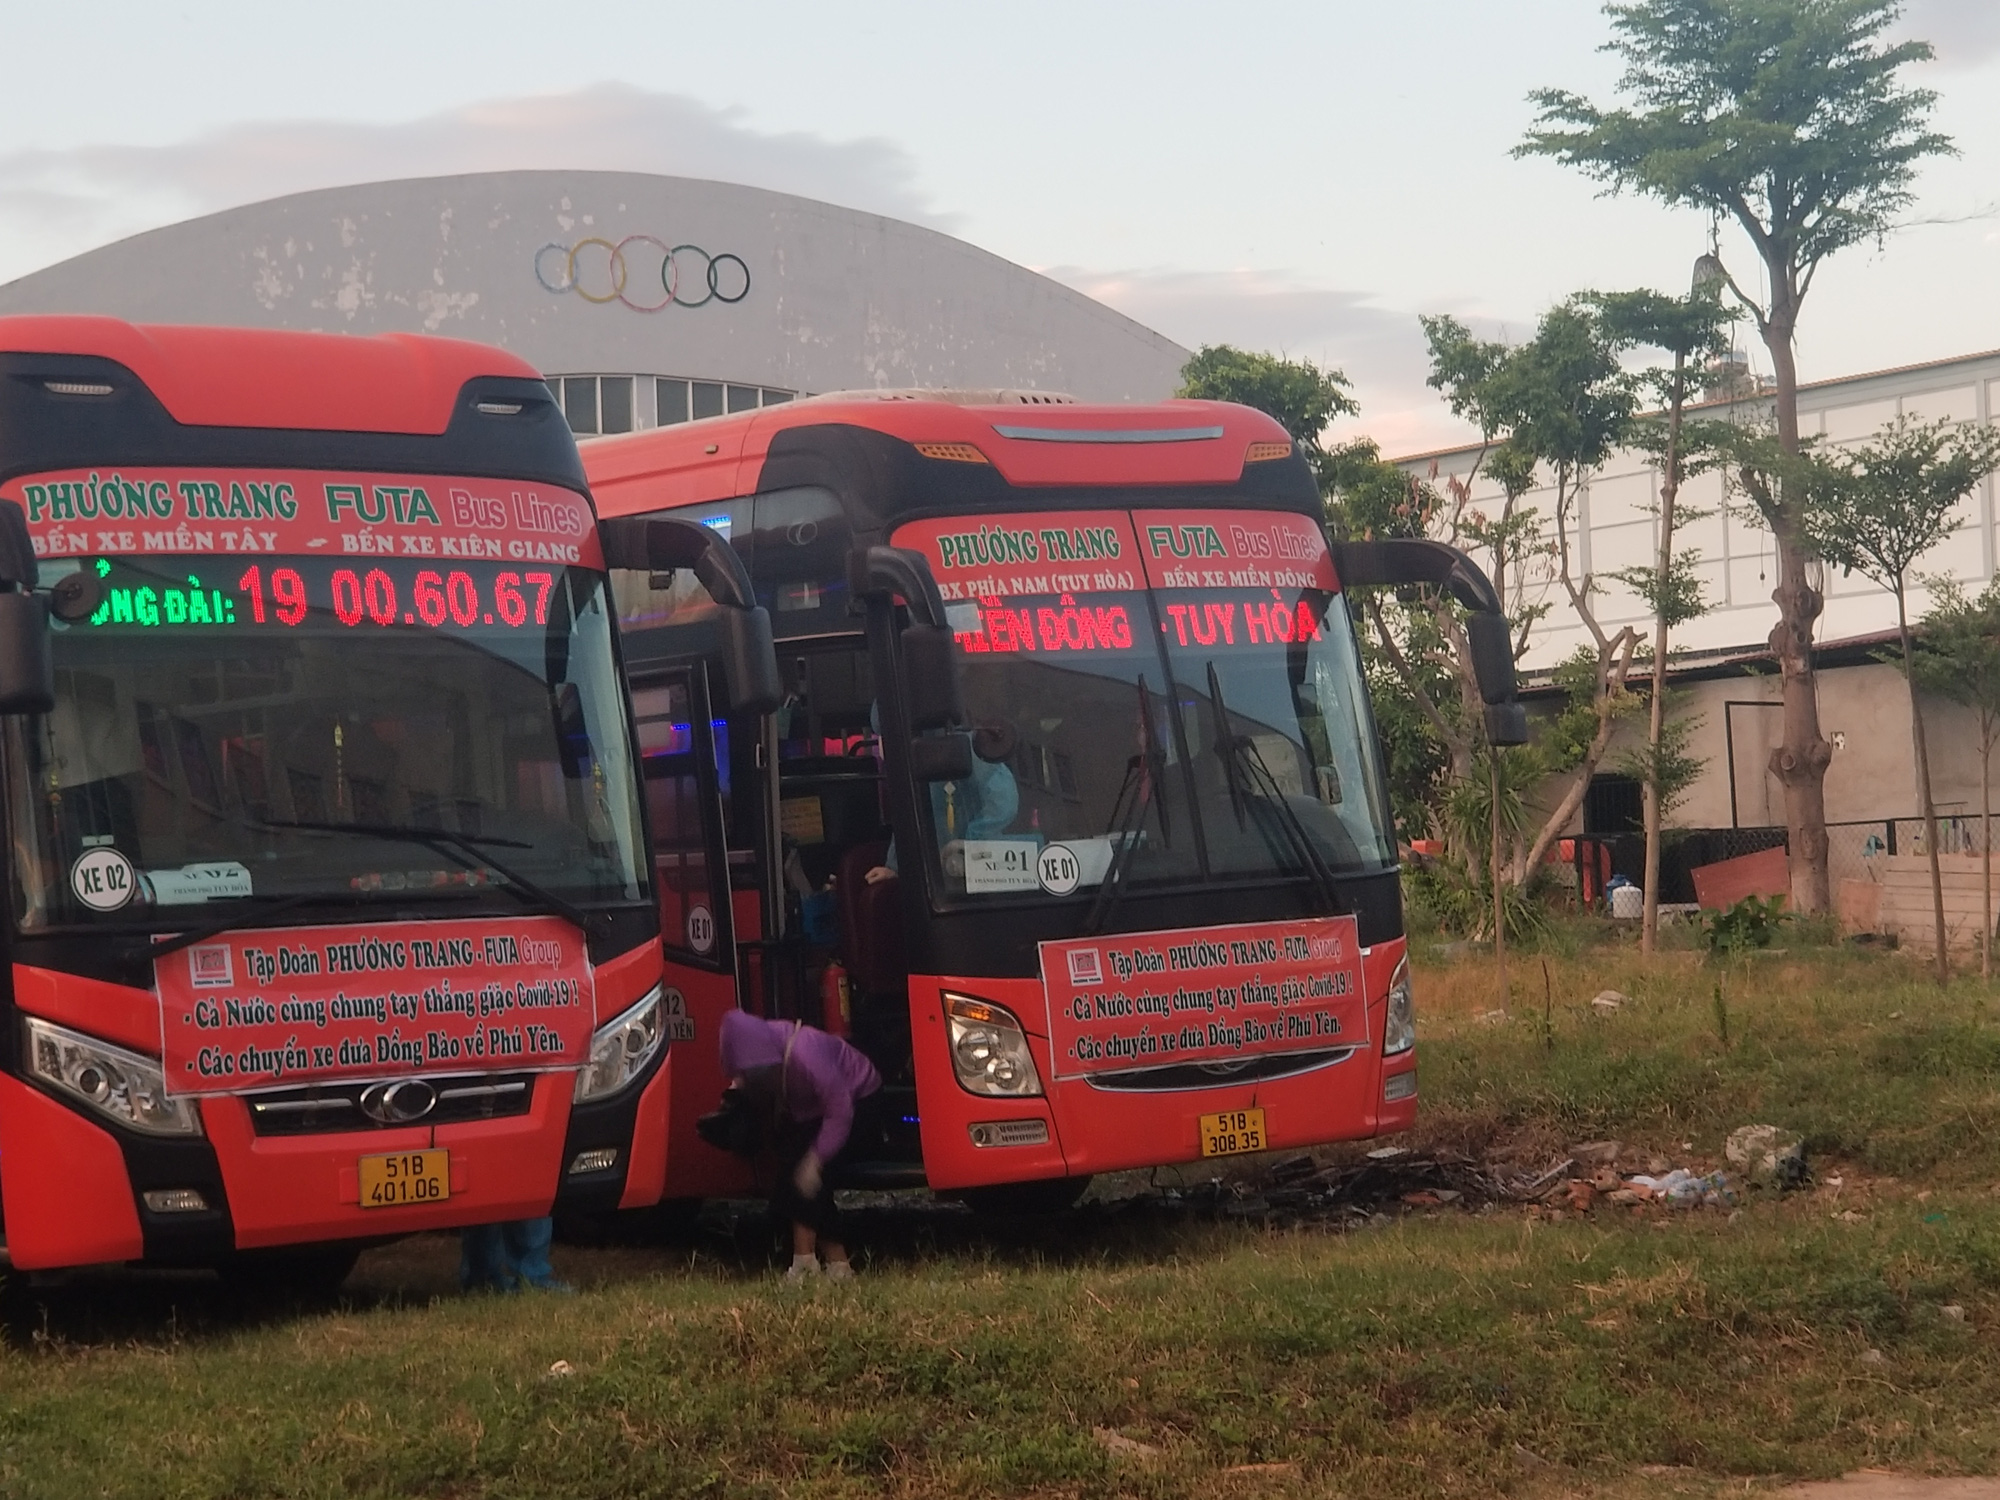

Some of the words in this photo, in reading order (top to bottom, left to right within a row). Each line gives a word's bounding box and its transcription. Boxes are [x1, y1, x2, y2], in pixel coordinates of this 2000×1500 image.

[23, 472, 173, 522] PHƯƠNG
[179, 480, 298, 520] TRANG
[324, 483, 442, 526] FUTA
[450, 488, 507, 529] Bus
[512, 491, 582, 536] Lines
[31, 524, 88, 554] BẾN
[93, 532, 136, 550] XE
[142, 522, 215, 550] MIỀN
[220, 526, 278, 551] TÂY
[341, 525, 394, 553] BẾN
[401, 536, 436, 554] XE
[440, 534, 502, 557] KIÊN
[508, 541, 581, 562] GIANG
[937, 523, 1038, 569] PHƯƠNG
[1041, 526, 1120, 562] TRANG
[1146, 525, 1229, 559] FUTA
[1230, 525, 1271, 559] Bus
[1271, 525, 1321, 562] Lines
[91, 558, 160, 626] NG
[163, 574, 236, 624] ĐÀI:
[239, 565, 307, 627] 19
[331, 568, 553, 627] 00.60.67
[940, 584, 963, 600] BX
[1011, 576, 1049, 594] NAM
[1052, 573, 1090, 594] (TUY
[1094, 569, 1134, 591] HÒA)
[1163, 564, 1200, 588] BẾN
[1202, 571, 1227, 587] XE
[1229, 563, 1272, 587] MIỀN
[1274, 567, 1317, 588] ĐÔNG
[954, 594, 1036, 652] IỀN
[1037, 594, 1132, 650] ĐÔNG
[1243, 588, 1322, 645] HÒA
[80, 867, 104, 895] XE
[106, 863, 127, 891] 02
[1043, 859, 1059, 881] XE
[1061, 858, 1075, 880] 01
[691, 919, 701, 939] XE
[702, 919, 711, 939] 01
[244, 949, 276, 986] Tập
[279, 945, 320, 975] Đoàn
[326, 937, 407, 973] PHƯƠNG
[411, 938, 474, 968] TRANG
[484, 936, 519, 966] FUTA
[520, 935, 561, 971] Group
[1108, 952, 1133, 982] Tập
[1133, 948, 1165, 974] Đoàn
[1168, 939, 1227, 970] PHƯƠNG
[1230, 939, 1276, 965] TRANG
[1284, 936, 1311, 960] FUTA
[1311, 935, 1342, 964] Group
[195, 996, 221, 1029] Cả
[225, 996, 276, 1028] Nước
[280, 994, 326, 1030] cùng
[331, 991, 387, 1024] chung
[390, 992, 418, 1021] tay
[423, 979, 476, 1021] thắng
[480, 982, 513, 1016] giặc
[516, 979, 570, 1009] Covid-19
[665, 995, 680, 1016] 12
[1073, 993, 1092, 1020] Cả
[1095, 992, 1133, 1018] Nước
[1136, 989, 1170, 1018] cùng
[1173, 987, 1214, 1013] chung
[1216, 986, 1237, 1010] tay
[1240, 973, 1278, 1007] thắng
[1280, 976, 1305, 1006] giặc
[1308, 971, 1346, 998] Covid-19
[674, 1019, 693, 1038] YÊN
[1077, 1035, 1102, 1060] Các
[1105, 1025, 1157, 1060] chuyến
[1160, 1033, 1176, 1051] xe
[1180, 1025, 1205, 1049] đưa
[1208, 1017, 1241, 1050] Đồng
[1244, 1019, 1267, 1043] Bào
[1270, 1011, 1284, 1039] về
[1288, 1012, 1311, 1038] Phú
[1315, 1011, 1341, 1035] Yên.
[198, 1047, 234, 1078] Các
[239, 1036, 308, 1078] chuyến
[313, 1045, 333, 1068] xe
[339, 1038, 371, 1065] đưa
[376, 1028, 423, 1068] Đồng
[427, 1031, 460, 1060] Bào
[464, 1023, 484, 1056] về
[488, 1026, 522, 1056] Phú
[527, 1024, 564, 1053] Yên.
[1218, 1113, 1246, 1132] 51B
[1209, 1131, 1259, 1153] 308.35
[386, 1155, 423, 1178] 51B
[371, 1177, 439, 1203] 401.06
